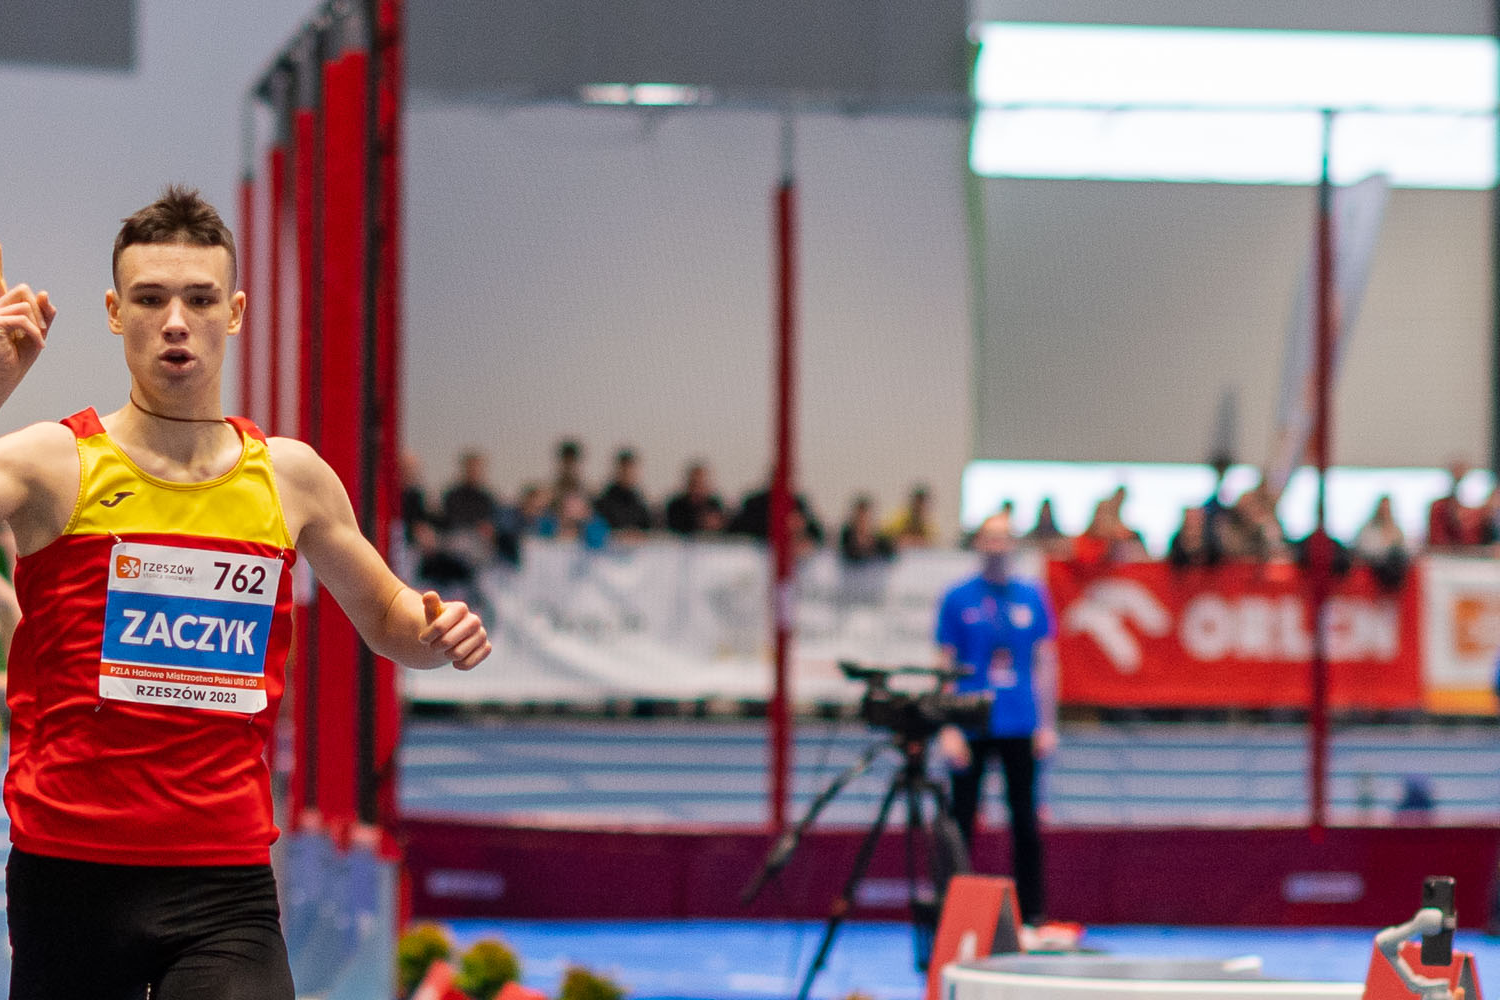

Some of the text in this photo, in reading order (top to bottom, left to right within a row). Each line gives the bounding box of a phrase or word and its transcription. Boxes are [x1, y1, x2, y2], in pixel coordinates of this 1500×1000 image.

[143, 561, 267, 595] rzeszów 762
[119, 608, 258, 655] ZACZYK
[110, 665, 131, 676] PZLA
[132, 668, 165, 679] Halowe
[165, 671, 214, 684] Mistrzostwa
[214, 675, 234, 685] Polski
[136, 685, 237, 704] RZESZÓW 2023
